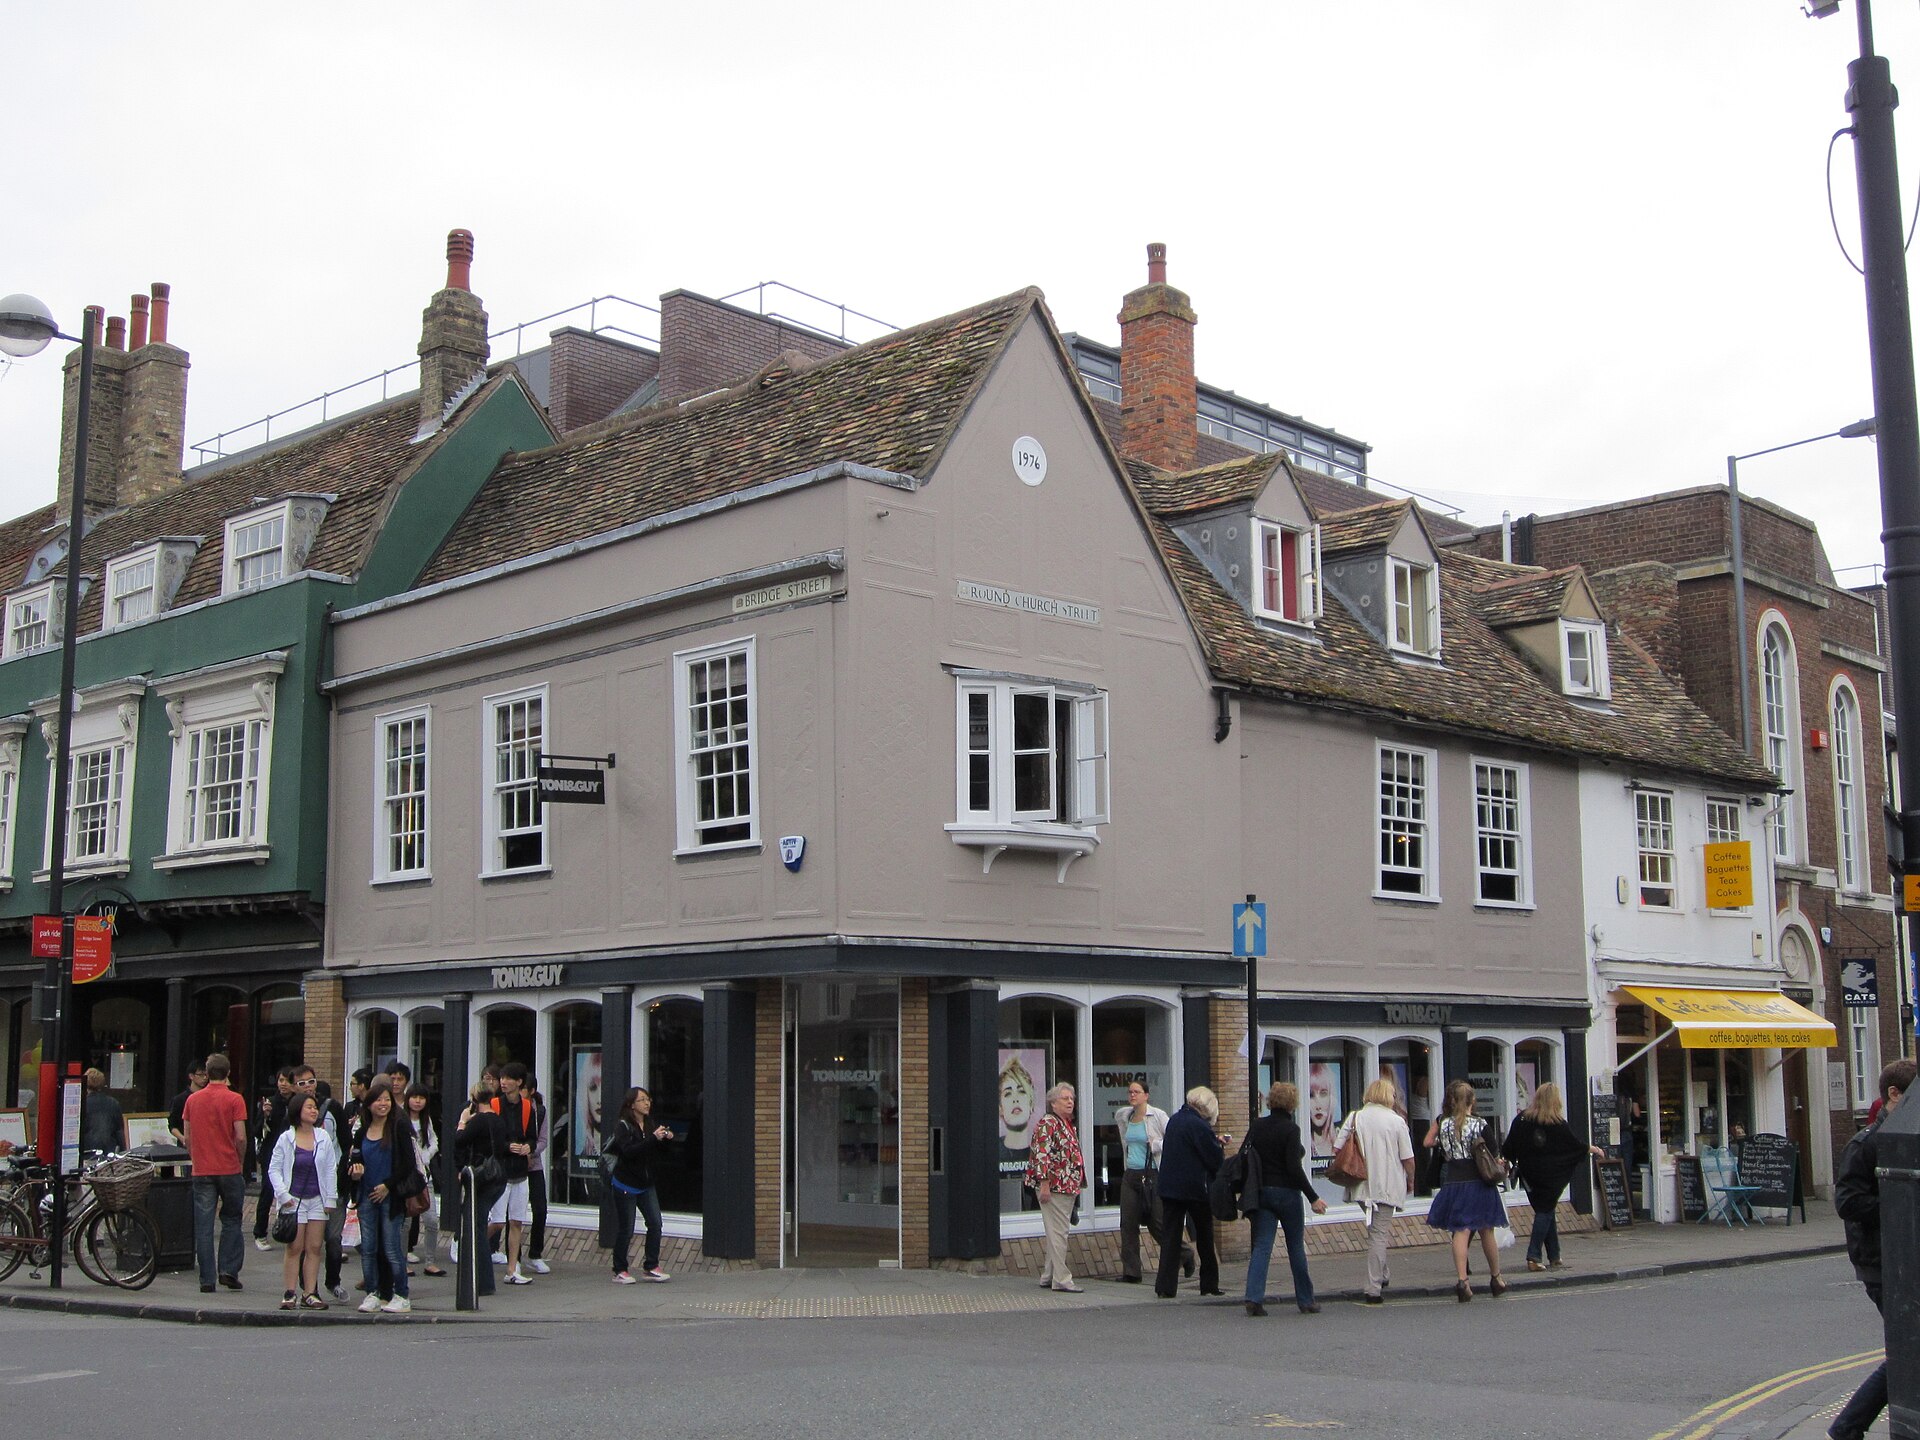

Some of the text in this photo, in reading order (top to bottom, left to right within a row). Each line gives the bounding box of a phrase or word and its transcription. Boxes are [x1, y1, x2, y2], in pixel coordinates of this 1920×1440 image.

[1019, 451, 1040, 470] 1976
[745, 577, 827, 607] BRIDGE STREET
[540, 779, 600, 793] TONI&GUY
[1713, 852, 1741, 862] Coffee
[1706, 864, 1750, 875] Baguettes
[1719, 876, 1738, 885] Teas
[1716, 888, 1742, 897] Cakes
[39, 929, 50, 938] park
[491, 964, 563, 989] TONI&GUY
[1844, 993, 1876, 1001] CATS
[1384, 1003, 1452, 1024] TONI&GUY
[1709, 1032, 1810, 1045] coffee, baguettes, teas, cakes
[811, 1070, 882, 1082] TONI&GUY
[1468, 1077, 1499, 1089] NI&GUY
[999, 1161, 1029, 1172] NI&GUY
